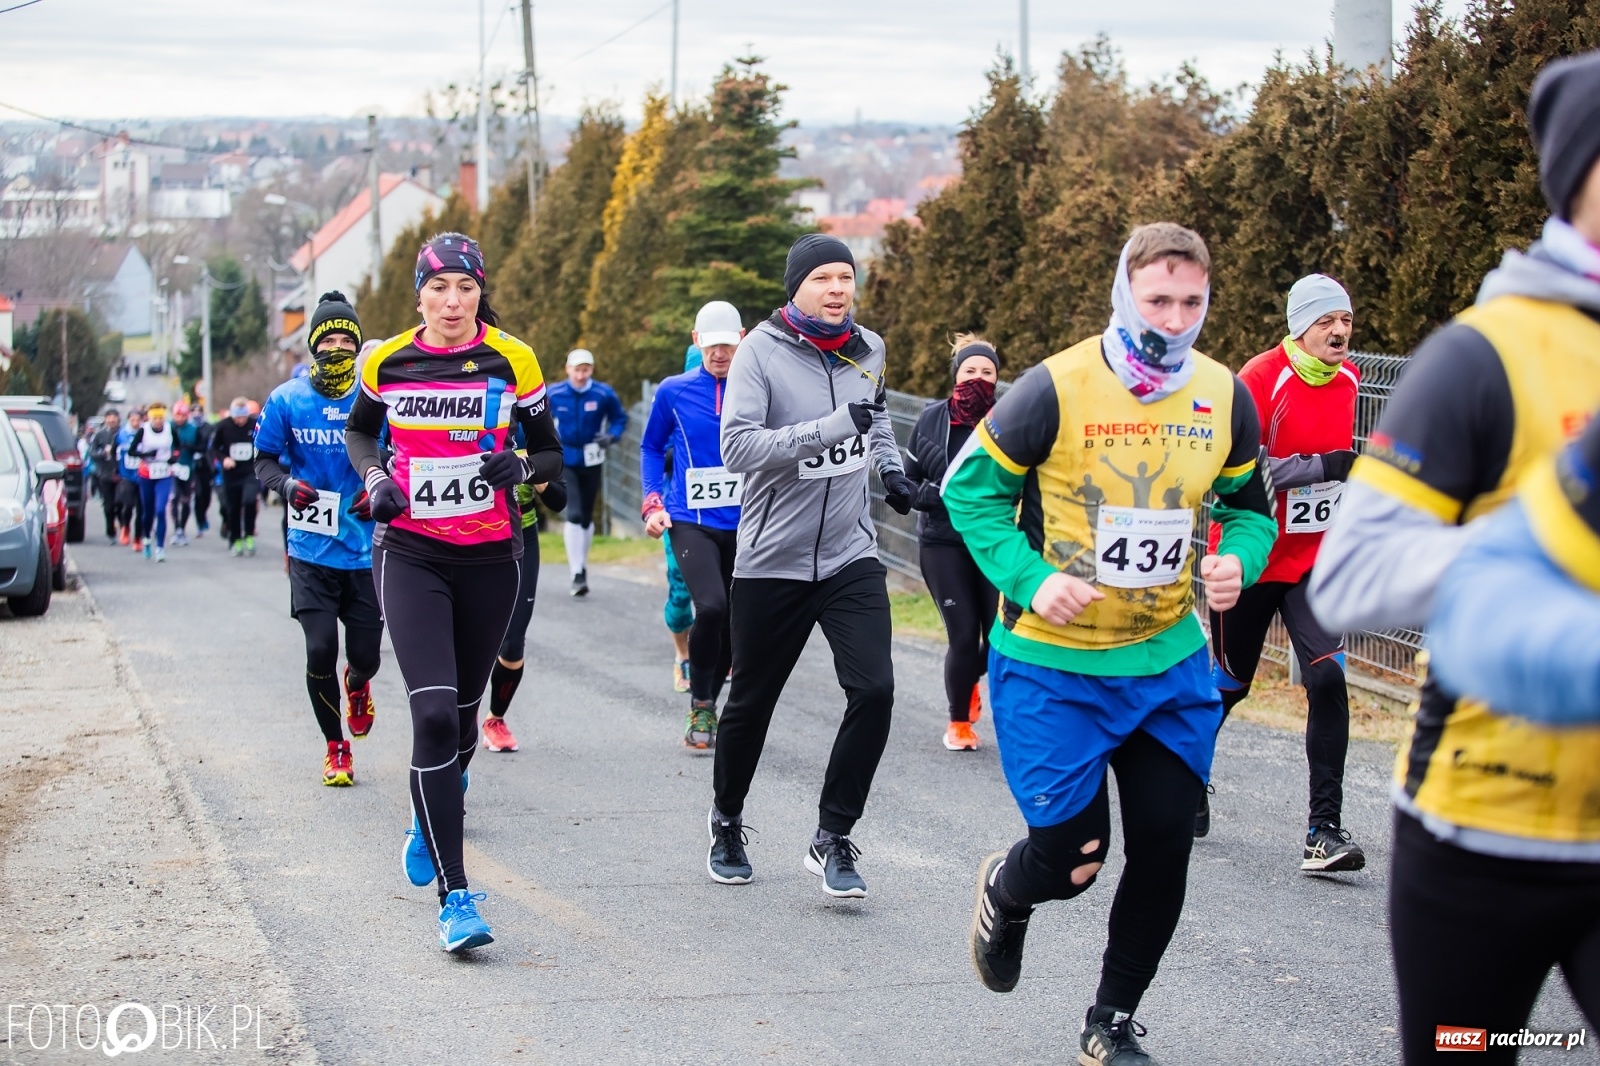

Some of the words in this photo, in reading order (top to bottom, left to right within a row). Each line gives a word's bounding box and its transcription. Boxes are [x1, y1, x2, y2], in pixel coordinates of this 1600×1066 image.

[395, 396, 483, 419] CARAMBA
[448, 430, 479, 443] TEAM
[1084, 437, 1214, 452] BOLATICE
[414, 475, 491, 507] 446
[691, 480, 739, 500] 257
[1101, 537, 1184, 573] 434
